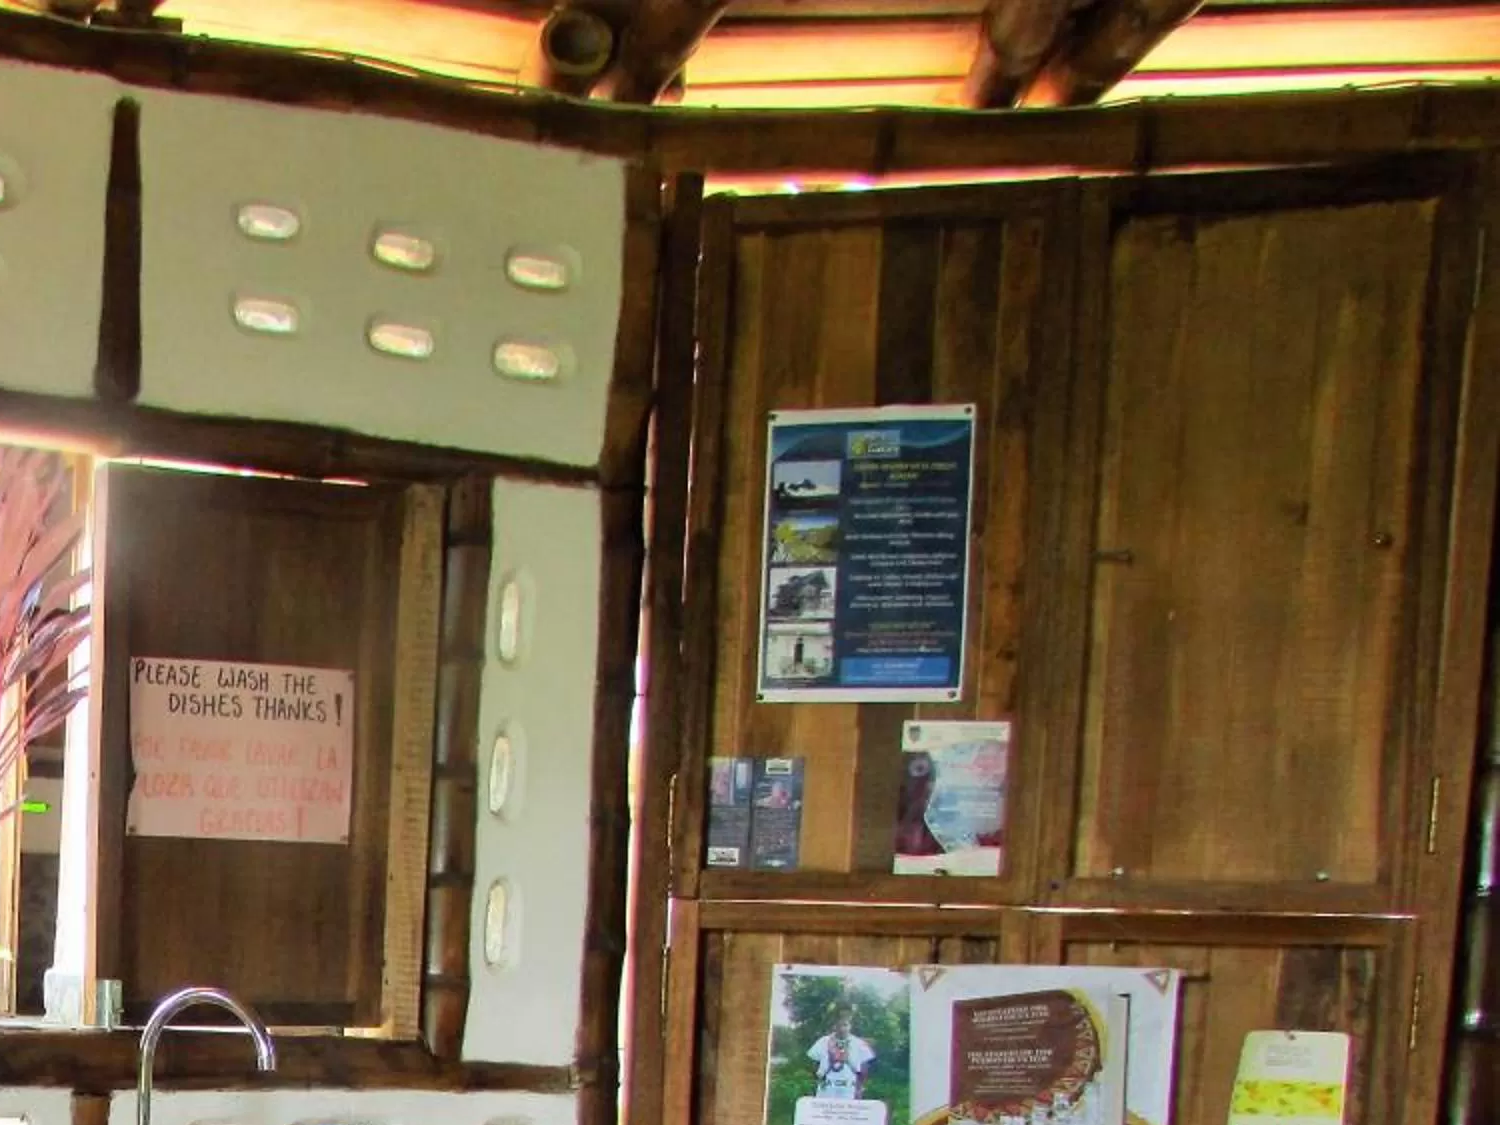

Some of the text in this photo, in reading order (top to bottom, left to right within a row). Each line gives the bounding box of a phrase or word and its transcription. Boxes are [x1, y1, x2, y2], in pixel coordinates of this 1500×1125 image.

[134, 659, 317, 695] PLEASE WASH THE
[168, 693, 243, 718] DISHES
[253, 696, 327, 723] THANKS
[316, 744, 338, 770] LA
